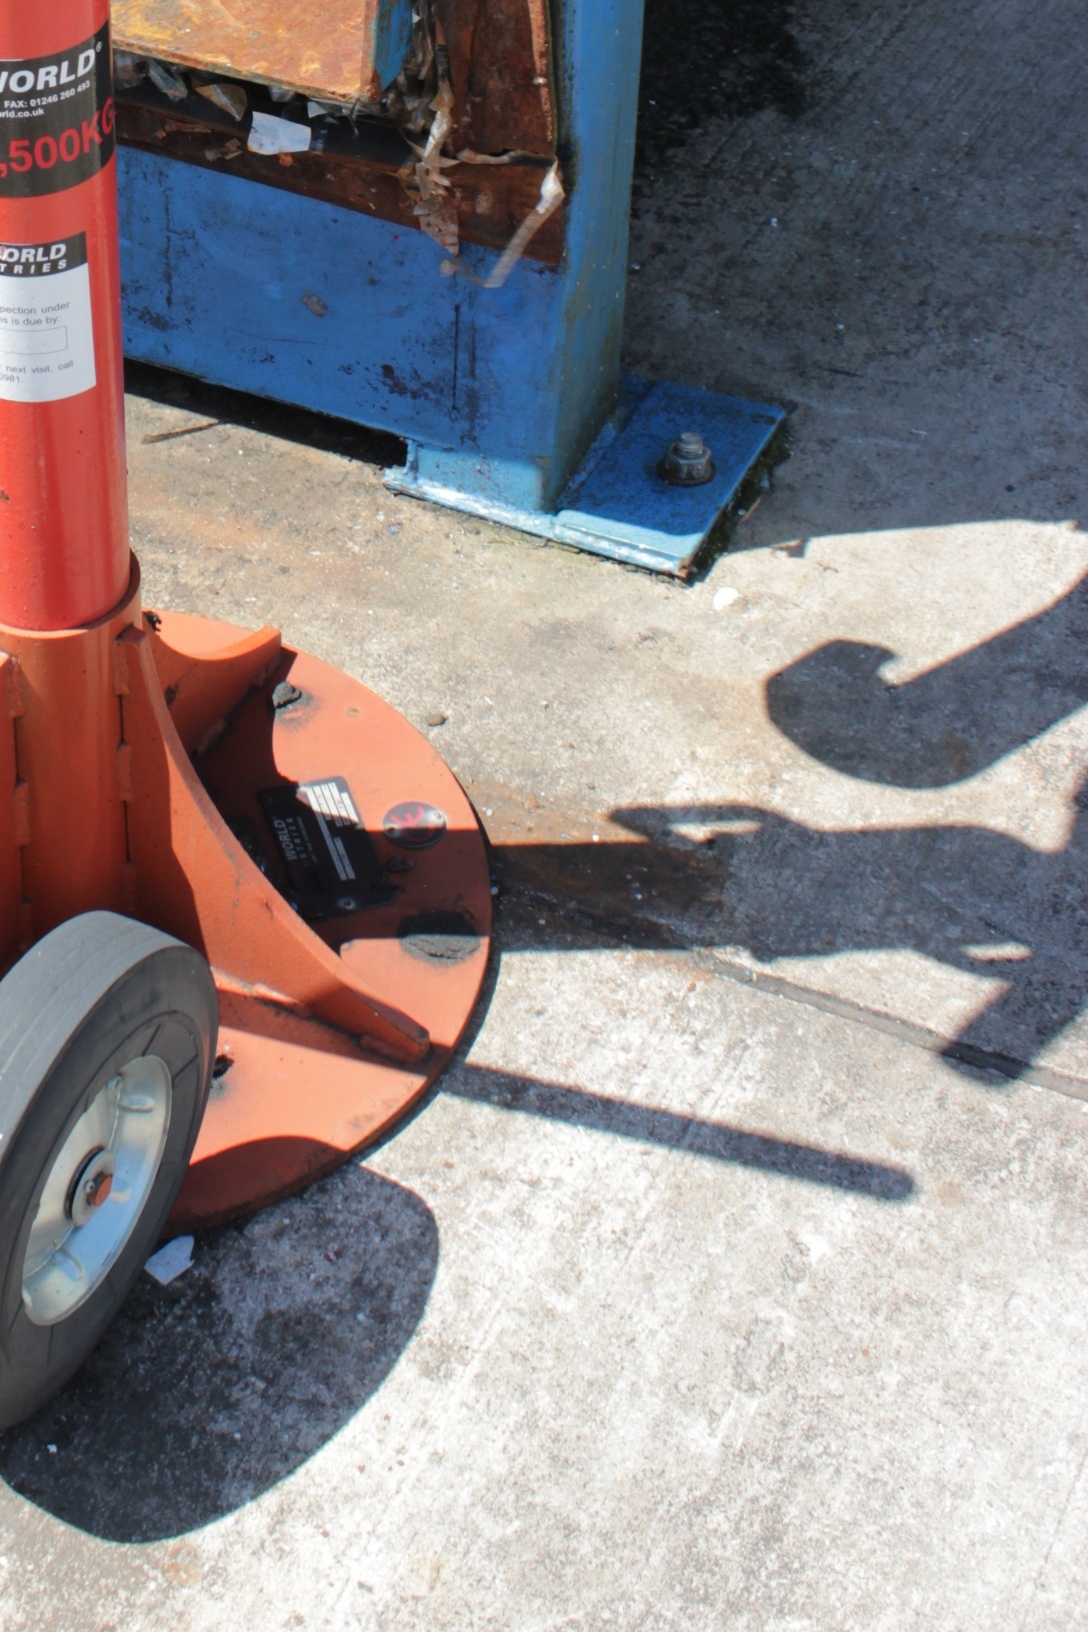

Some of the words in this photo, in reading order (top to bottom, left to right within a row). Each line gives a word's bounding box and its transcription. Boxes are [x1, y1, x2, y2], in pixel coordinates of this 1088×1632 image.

[4, 100, 28, 109] FAX:
[30, 94, 58, 107] 01246
[60, 88, 75, 101] 260
[77, 80, 91, 93] 493
[41, 301, 70, 314] under
[11, 317, 20, 326] is
[22, 316, 43, 326] due
[6, 365, 27, 374] next
[57, 359, 74, 371] call
